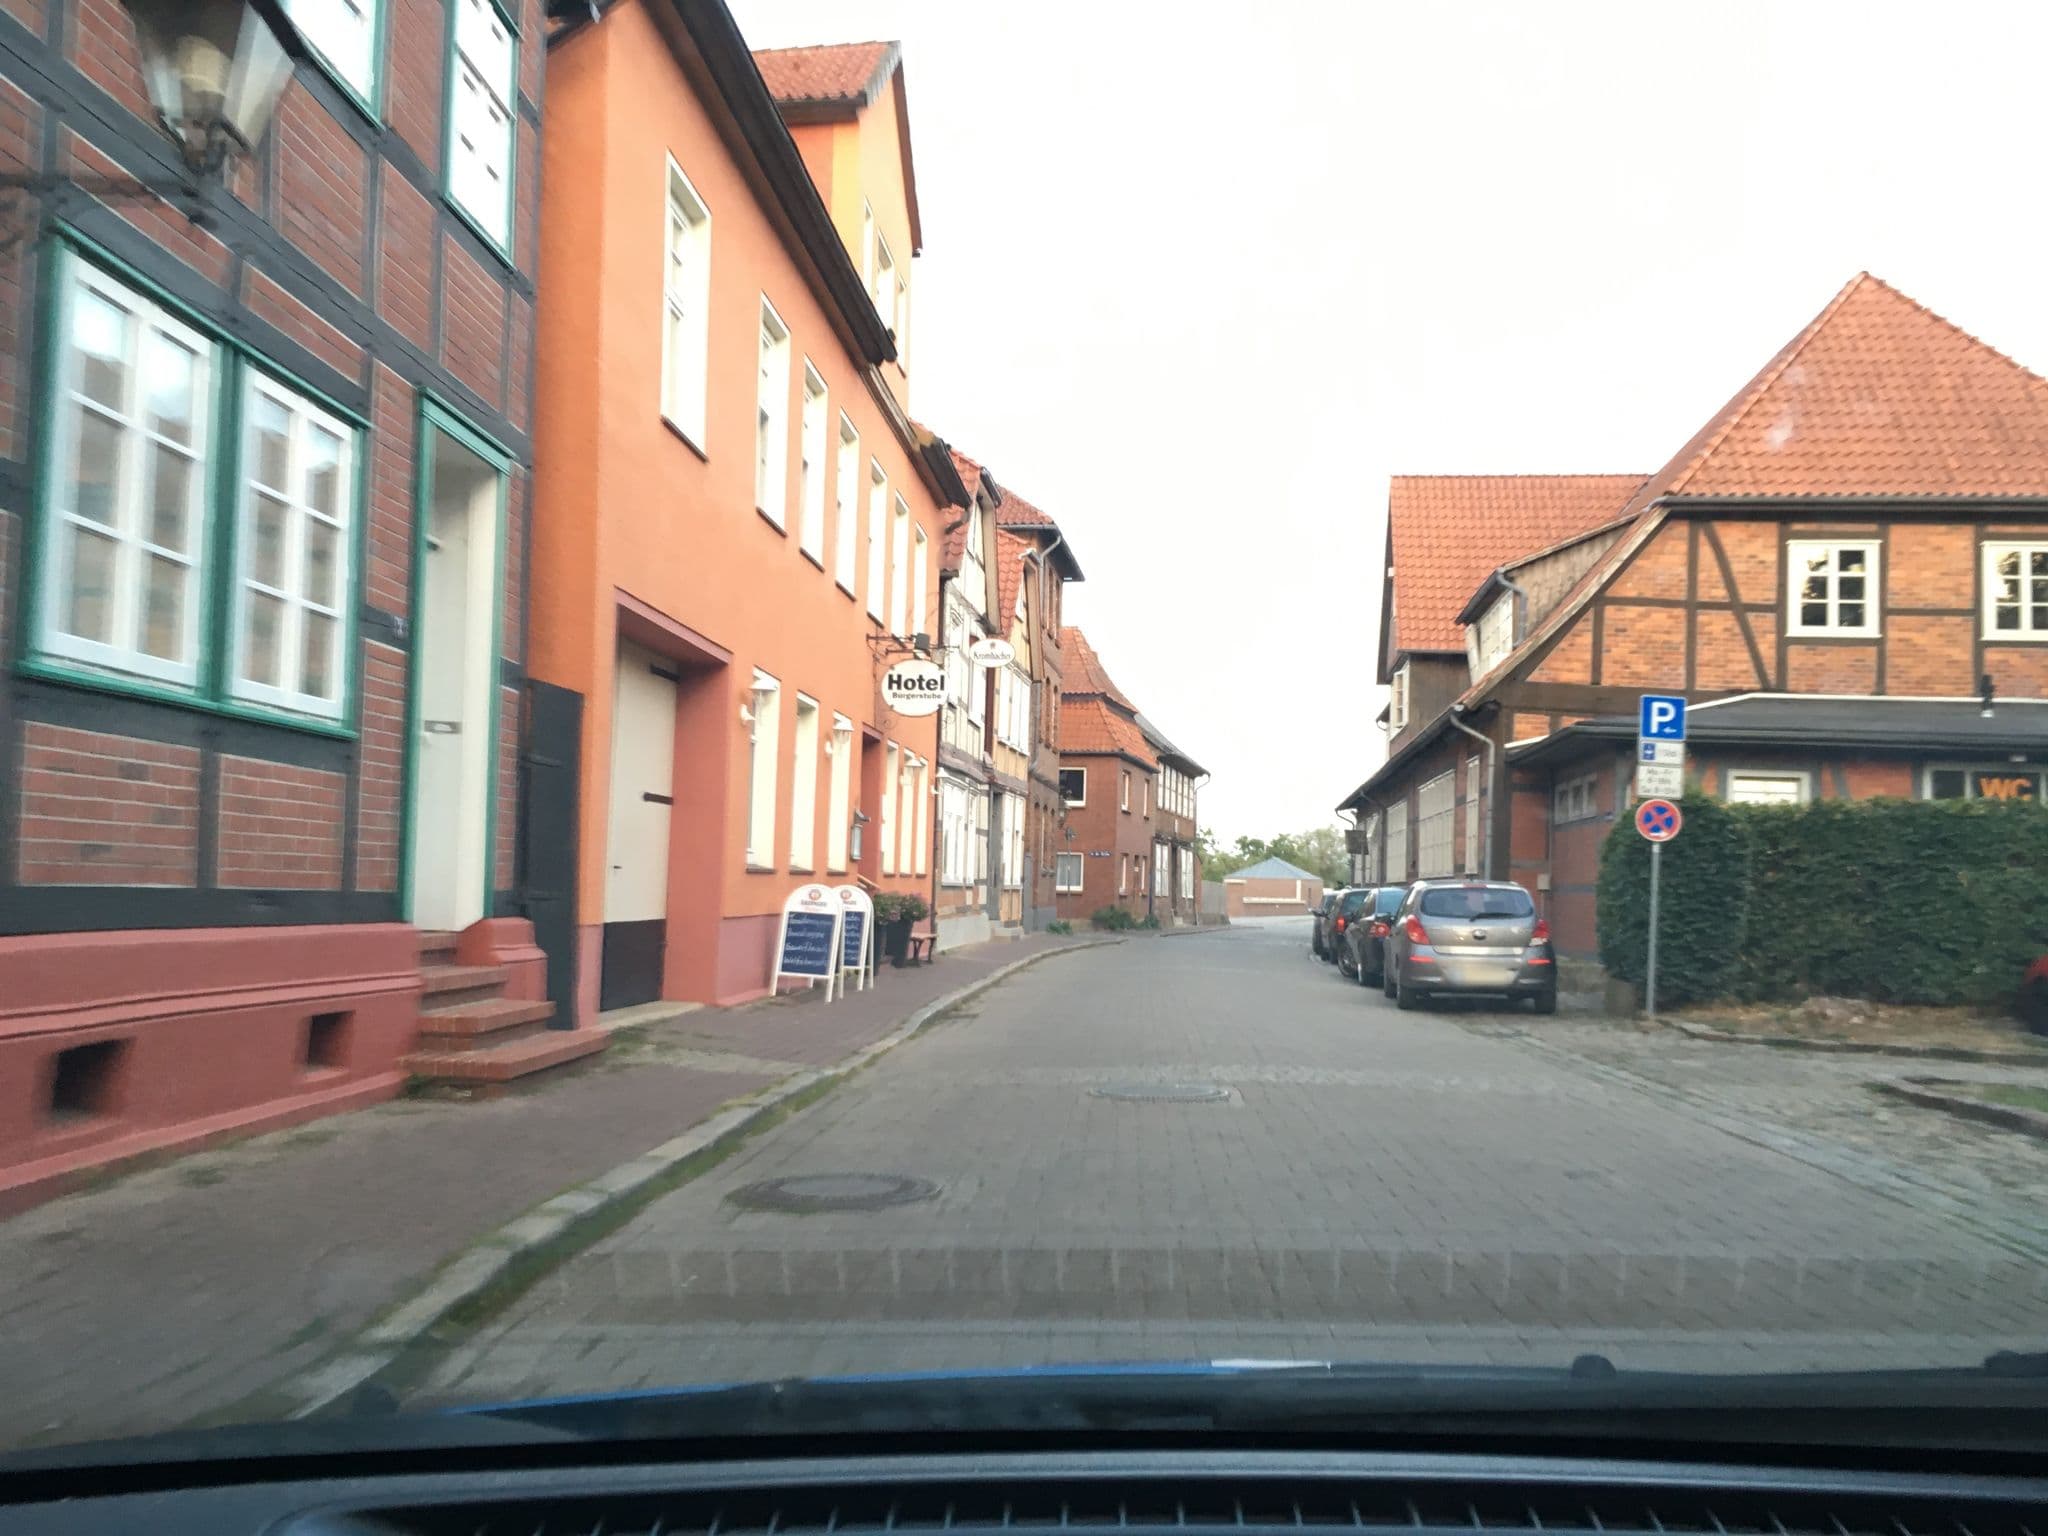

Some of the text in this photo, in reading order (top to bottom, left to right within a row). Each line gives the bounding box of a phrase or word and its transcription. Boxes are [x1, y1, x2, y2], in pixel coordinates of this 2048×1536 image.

[887, 673, 945, 691] Hotel
[1650, 701, 1676, 734] P
[1980, 777, 2032, 801] WC
